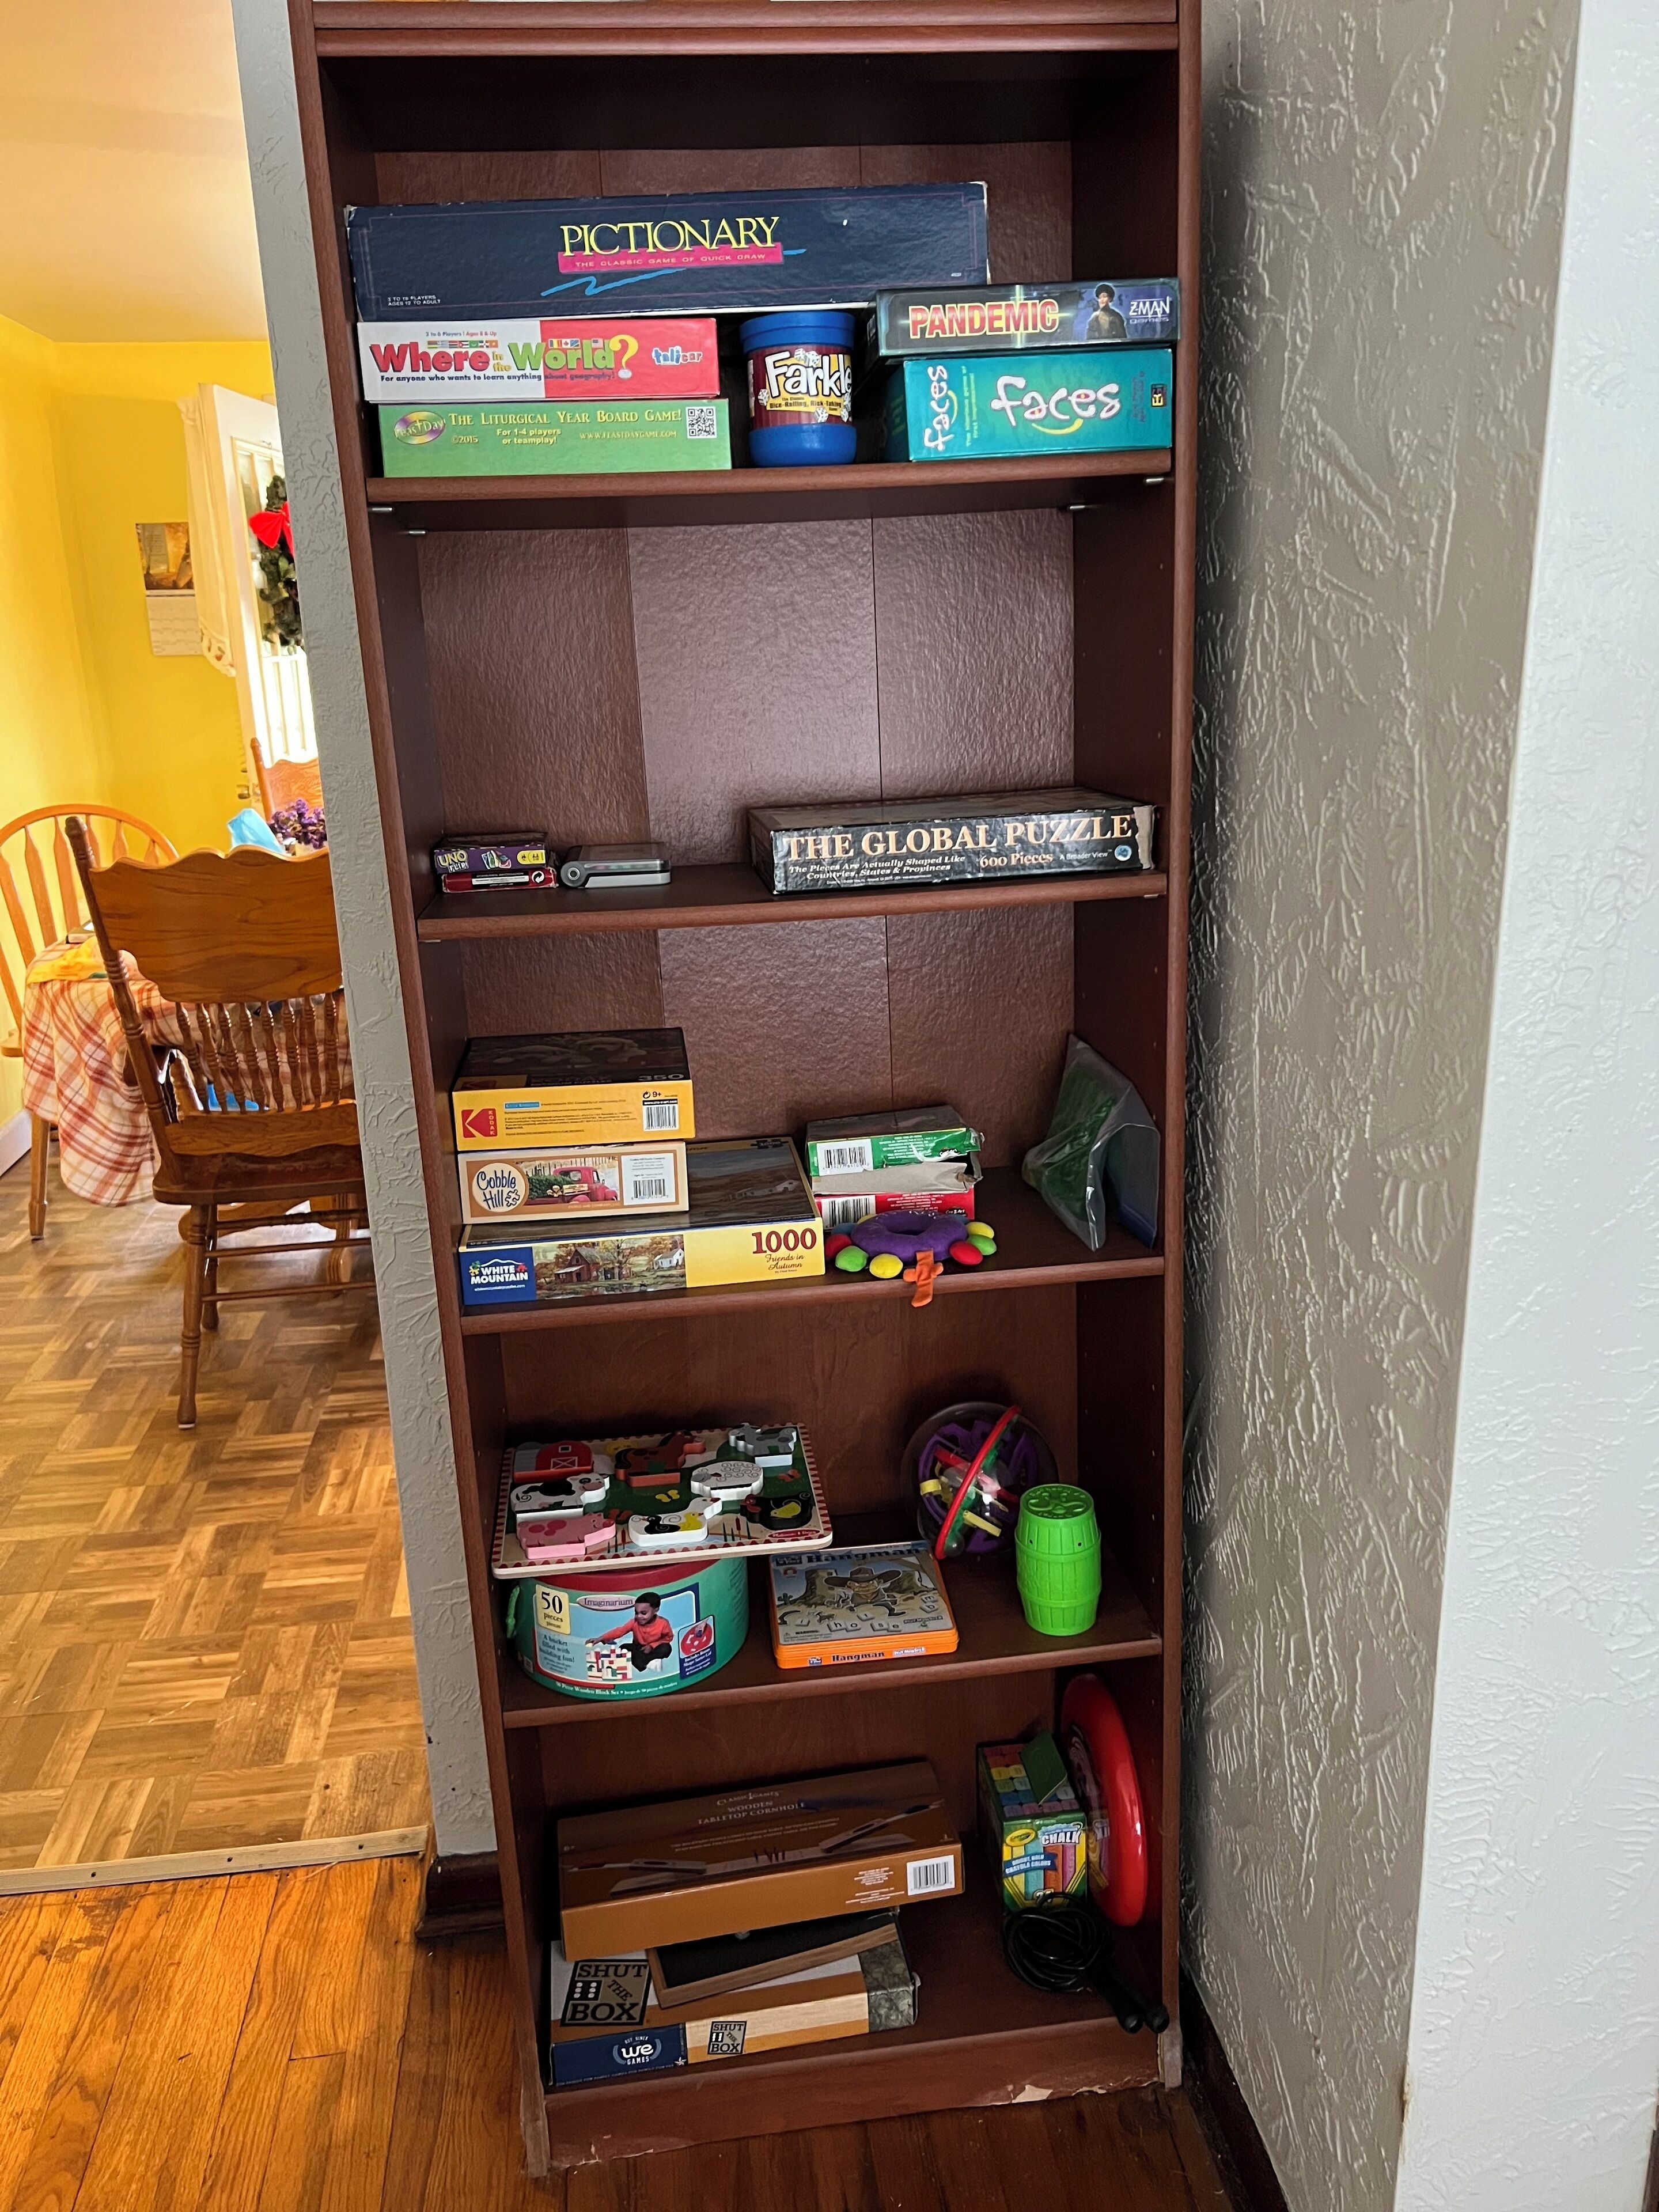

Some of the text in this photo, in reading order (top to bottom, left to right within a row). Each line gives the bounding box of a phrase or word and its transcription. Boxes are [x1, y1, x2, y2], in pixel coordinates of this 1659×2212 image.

[560, 217, 779, 256] PICTIONARY
[908, 299, 1059, 339] PANDEMIC
[369, 342, 490, 373] Where
[493, 351, 504, 361] in
[493, 362, 512, 372] the
[765, 351, 853, 397] Farkle
[507, 373, 542, 381] anything
[990, 375, 1121, 427] faces
[924, 365, 955, 452] faces
[529, 429, 562, 437] players
[514, 437, 557, 445] teamplay!
[783, 815, 1133, 861] THE GLOBAL PUZZLE
[437, 850, 468, 867] UNO
[789, 866, 807, 874] The
[810, 863, 840, 872] Pieces
[861, 859, 904, 870] Actually
[906, 857, 942, 867] Shaped
[944, 855, 966, 863] Like
[980, 852, 1054, 868] 600 Pieces
[806, 870, 858, 880] Countries,
[903, 865, 951, 874] Provinces
[477, 1169, 516, 1191] Cobble
[483, 1189, 504, 1210] Hill
[752, 1228, 817, 1255] 1000
[765, 1253, 795, 1263] Friends
[481, 1265, 516, 1274] WHITE
[768, 1262, 802, 1270] Autumn
[471, 1272, 529, 1285] MOUNTAIN
[806, 1548, 920, 1563] Hangman
[541, 1591, 563, 1614] 50
[584, 1597, 633, 1607] Imaginarium
[543, 1612, 563, 1623] pieces
[542, 1641, 556, 1650] filled
[548, 1635, 567, 1646] bucket
[539, 1647, 562, 1661] building
[832, 1652, 885, 1662] Hangman
[562, 1682, 574, 1691] Piece
[573, 1685, 594, 1694] Wooden
[698, 1802, 805, 1825] TABLETOP CORNHOLE
[728, 1801, 773, 1812] WOODEN
[1041, 1831, 1081, 1844] CHALK
[577, 1964, 647, 1978] SHUT
[608, 1979, 633, 2002] THE
[567, 2002, 639, 2021] BOX
[726, 2031, 738, 2043] THE
[622, 2044, 654, 2058] we
[710, 2043, 740, 2052] BOX
[627, 2056, 650, 2065] GAMES
